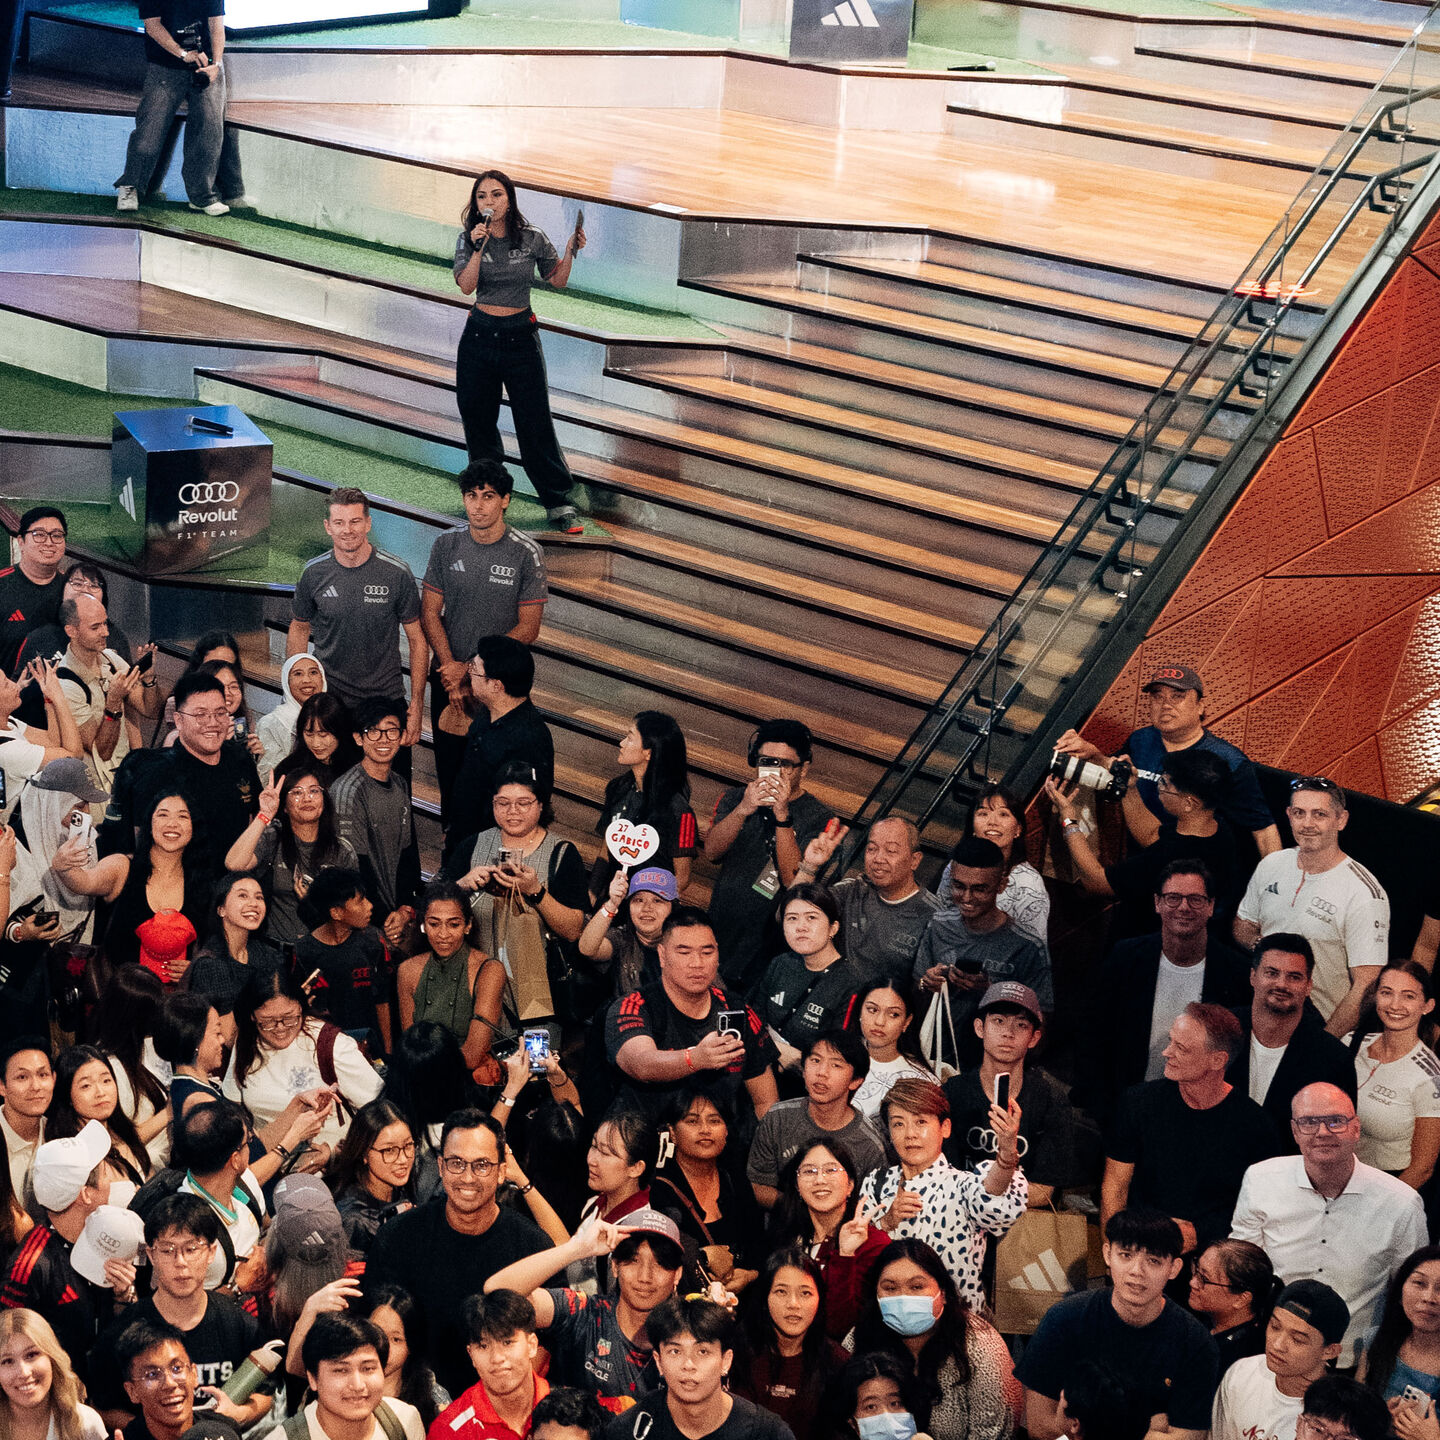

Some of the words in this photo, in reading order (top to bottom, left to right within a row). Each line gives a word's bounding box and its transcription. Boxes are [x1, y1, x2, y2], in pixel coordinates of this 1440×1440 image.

[178, 508, 238, 524] Revolut
[202, 529, 238, 538] TEAM
[618, 823, 629, 833] 27
[641, 827, 648, 837] 5
[611, 833, 650, 850] GABICO
